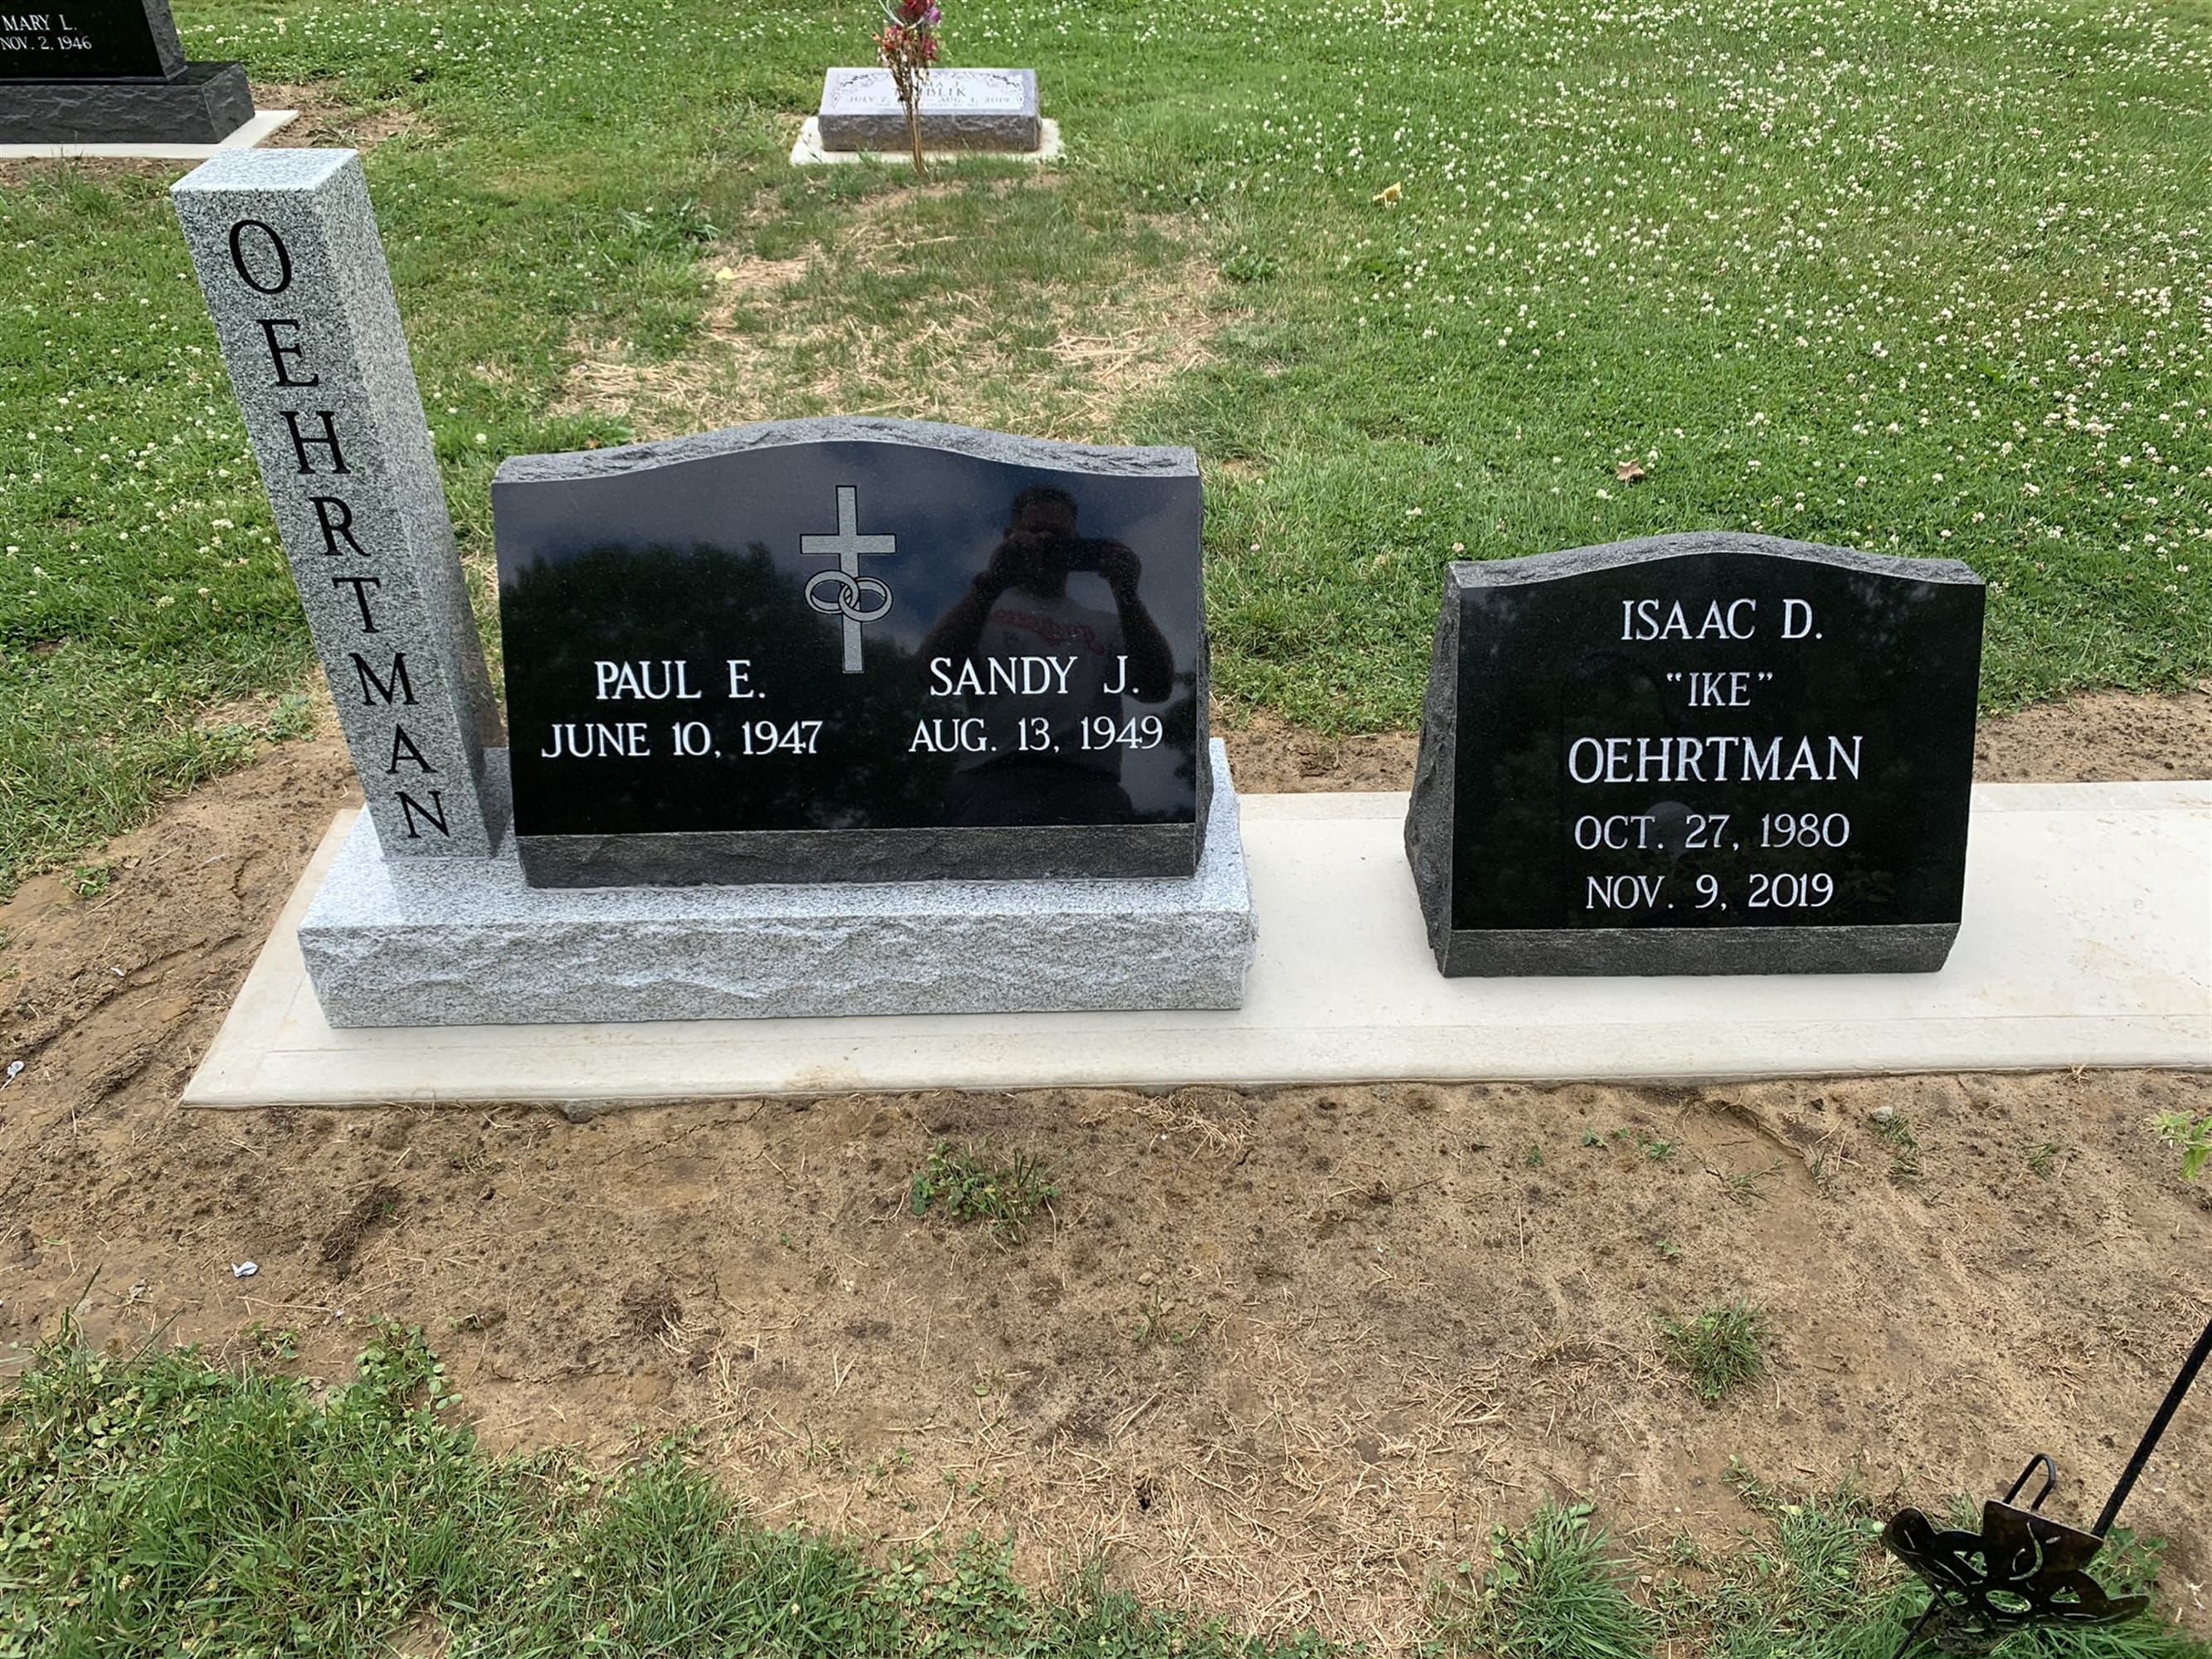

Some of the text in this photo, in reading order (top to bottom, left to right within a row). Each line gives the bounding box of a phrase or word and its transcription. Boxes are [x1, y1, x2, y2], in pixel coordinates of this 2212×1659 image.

[1, 14, 78, 32] MARY L.
[0, 36, 35, 51] NOV.
[57, 36, 92, 50] 1946
[228, 219, 451, 839] OEHRTMAN
[1621, 597, 1823, 641] ISAAC D.
[594, 659, 766, 700] PAUL E.
[929, 654, 1140, 697] SANDY J.
[540, 720, 824, 760] JUNE 10, 1947
[907, 715, 1163, 754] AUG. 13, 1949
[1568, 735, 1863, 784] OEHRTMAN
[1573, 813, 1850, 852] OCT. 27, 1980
[1585, 873, 1834, 912] NOV. 9, 2019
